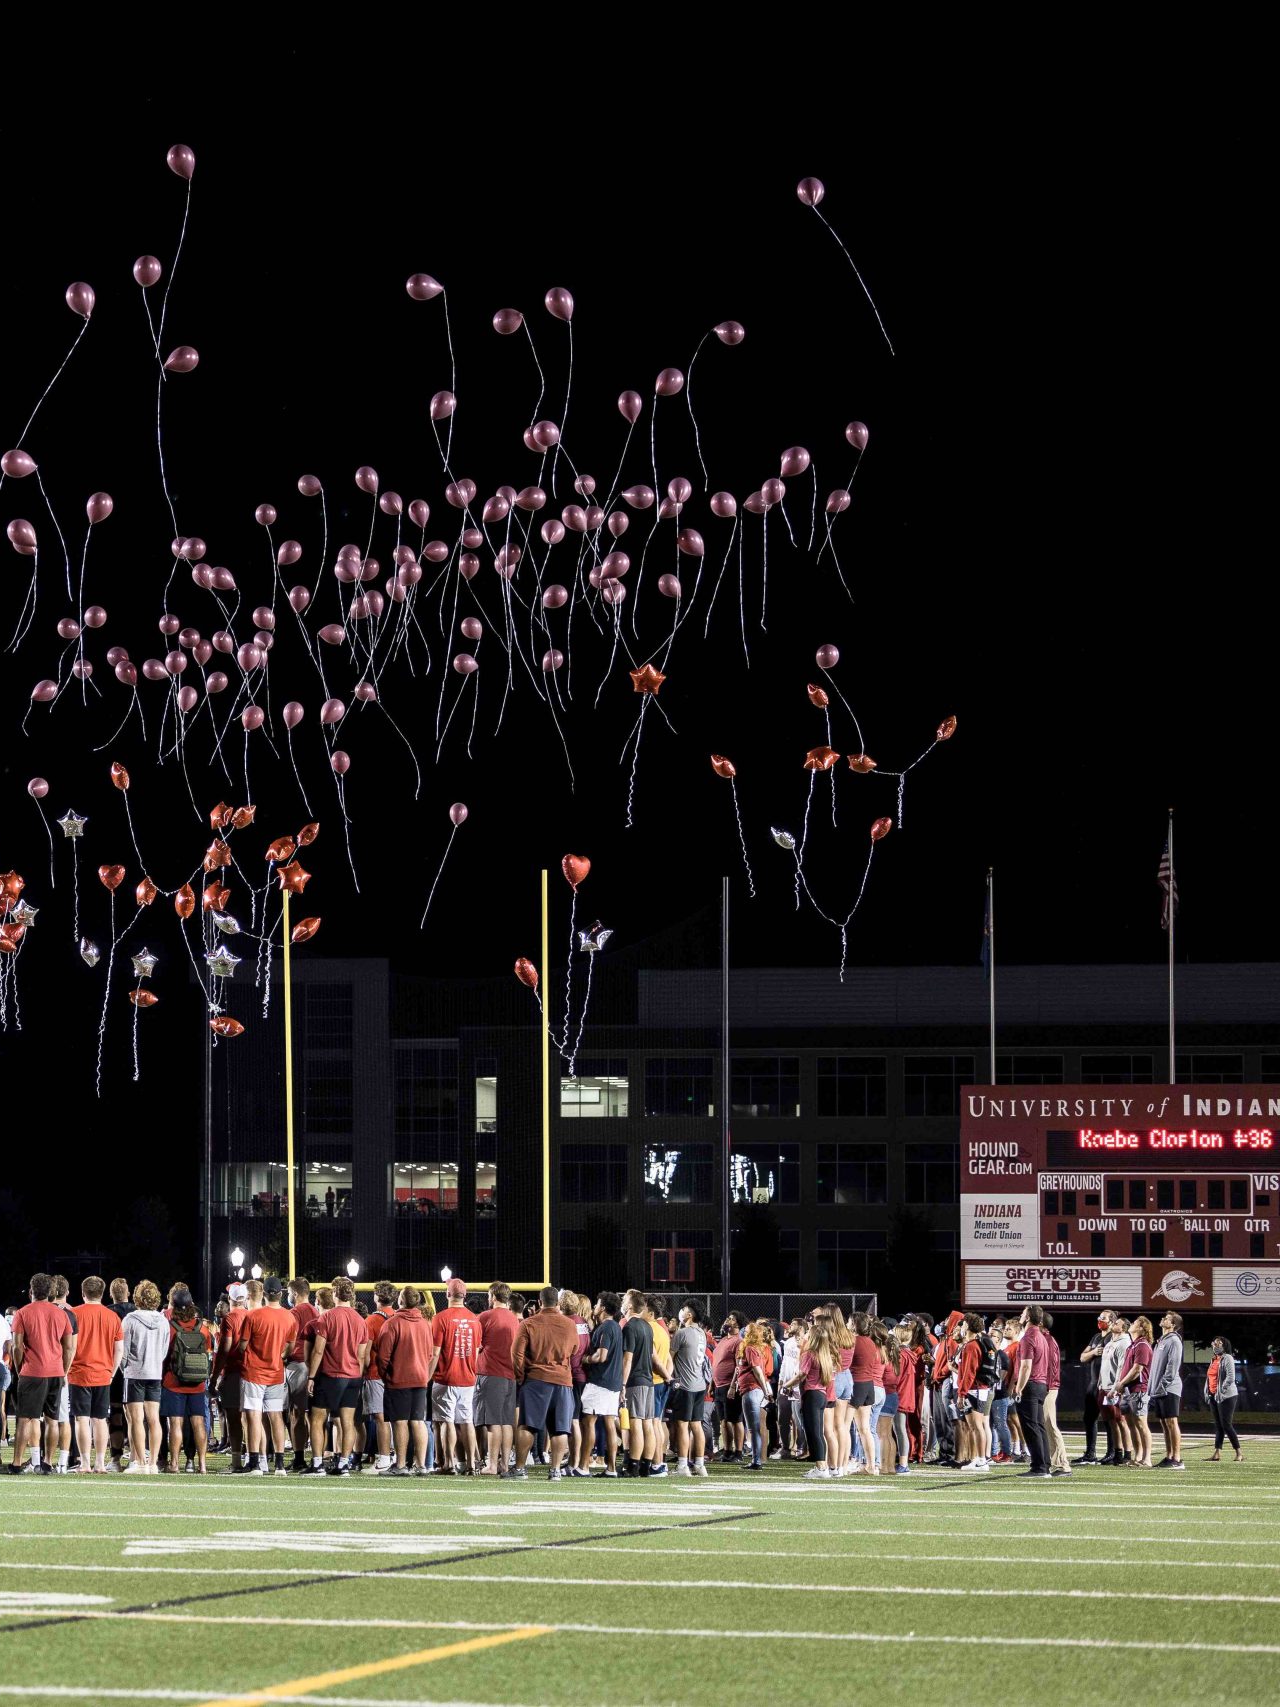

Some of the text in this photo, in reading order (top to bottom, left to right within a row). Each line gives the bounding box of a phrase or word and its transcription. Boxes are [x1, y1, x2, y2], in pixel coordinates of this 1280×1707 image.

[968, 1095, 1134, 1118] UNIVERSITY
[1147, 1097, 1170, 1118] of
[968, 1141, 1018, 1158] HOUND
[968, 1159, 1032, 1175] GEAR.COM
[1040, 1174, 1101, 1191] GREYHOUNDS
[973, 1204, 1022, 1218] INDIANA
[974, 1220, 1010, 1230] Members
[1078, 1218, 1117, 1231] DOWN
[1129, 1218, 1167, 1231] TO GO
[1184, 1219, 1230, 1231] BALL ON
[1244, 1219, 1270, 1232] QTR
[973, 1230, 1022, 1240] Credit Union
[1046, 1242, 1079, 1255] T.O.L.
[1005, 1280, 1101, 1293] CLUB
